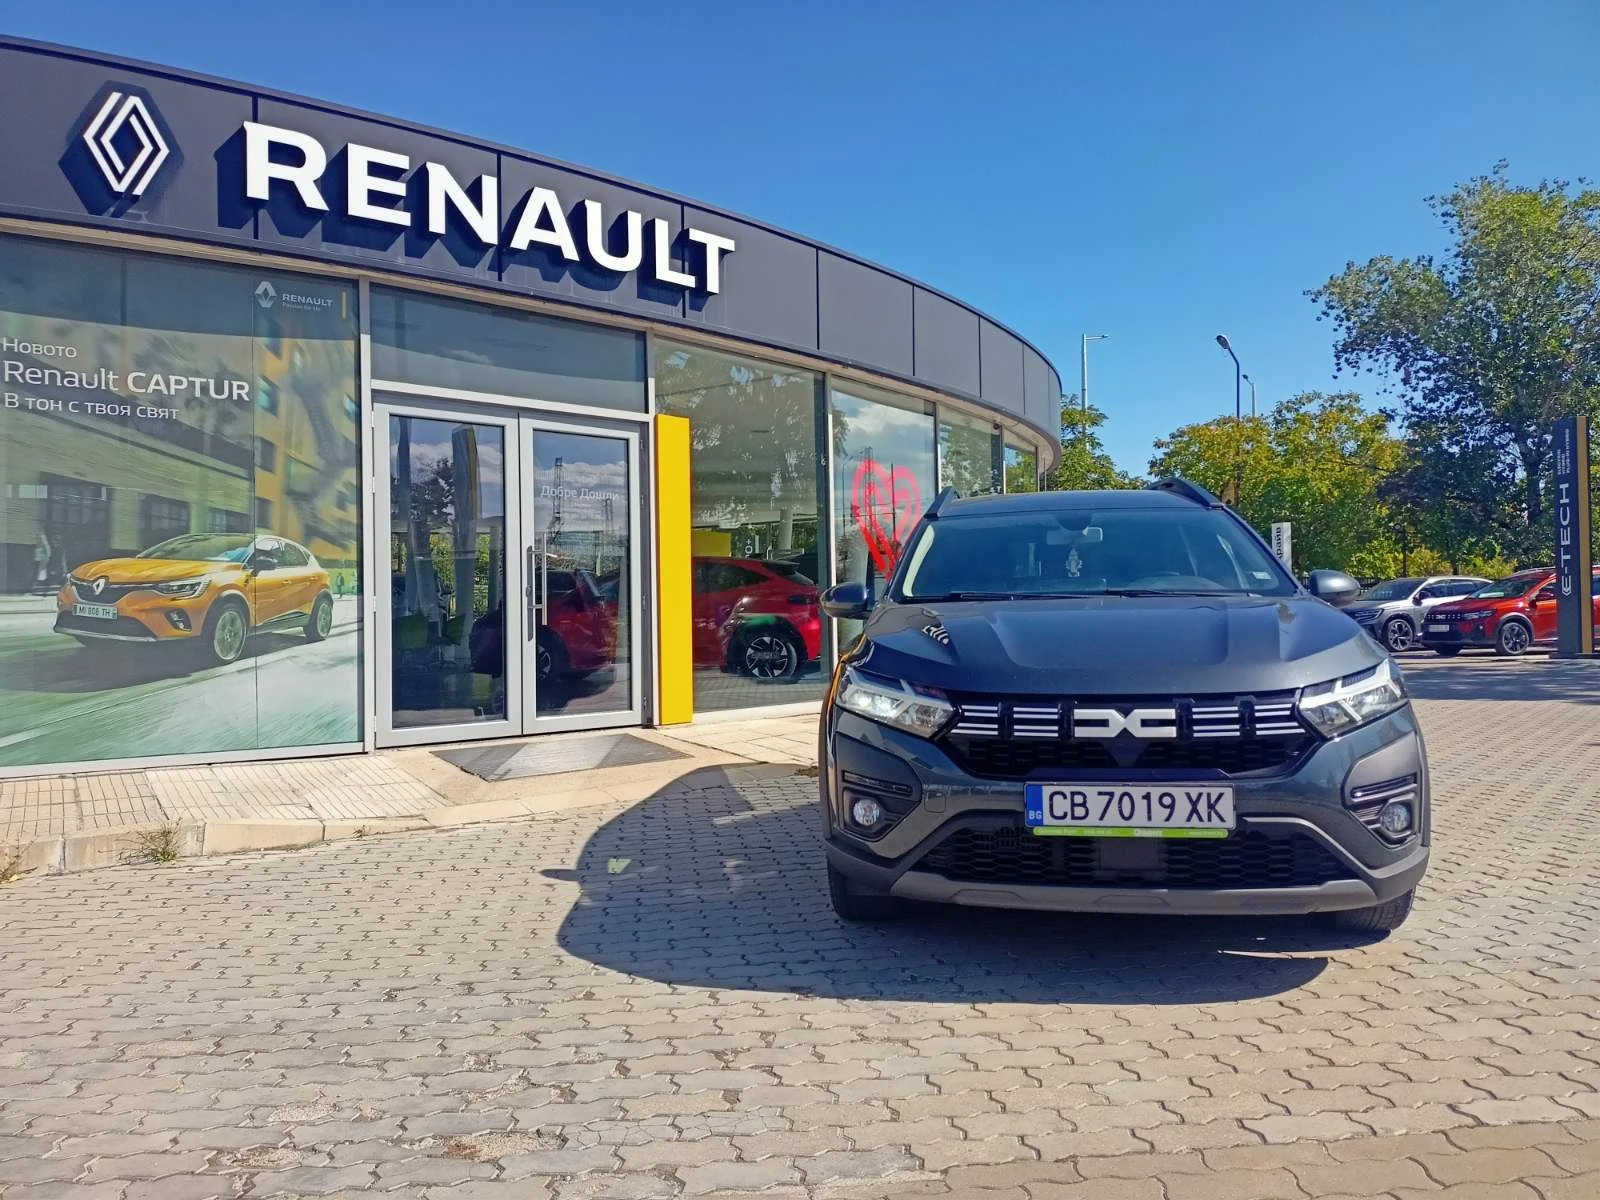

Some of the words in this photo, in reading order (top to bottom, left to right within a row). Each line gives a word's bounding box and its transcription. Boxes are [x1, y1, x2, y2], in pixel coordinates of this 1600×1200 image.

[243, 121, 736, 294] RENAULT
[282, 293, 333, 306] RENAULT
[3, 337, 77, 358] Новото
[3, 360, 119, 391] Renault
[127, 372, 250, 401] CAPTUR
[4, 393, 19, 408] В
[541, 485, 577, 500] Добре
[1275, 526, 1284, 559] райв
[1560, 483, 1572, 596] E-TECH
[1028, 810, 1042, 820] BG
[1049, 791, 1089, 821] CB
[1097, 792, 1176, 822] 7019
[1185, 792, 1226, 823] XK
